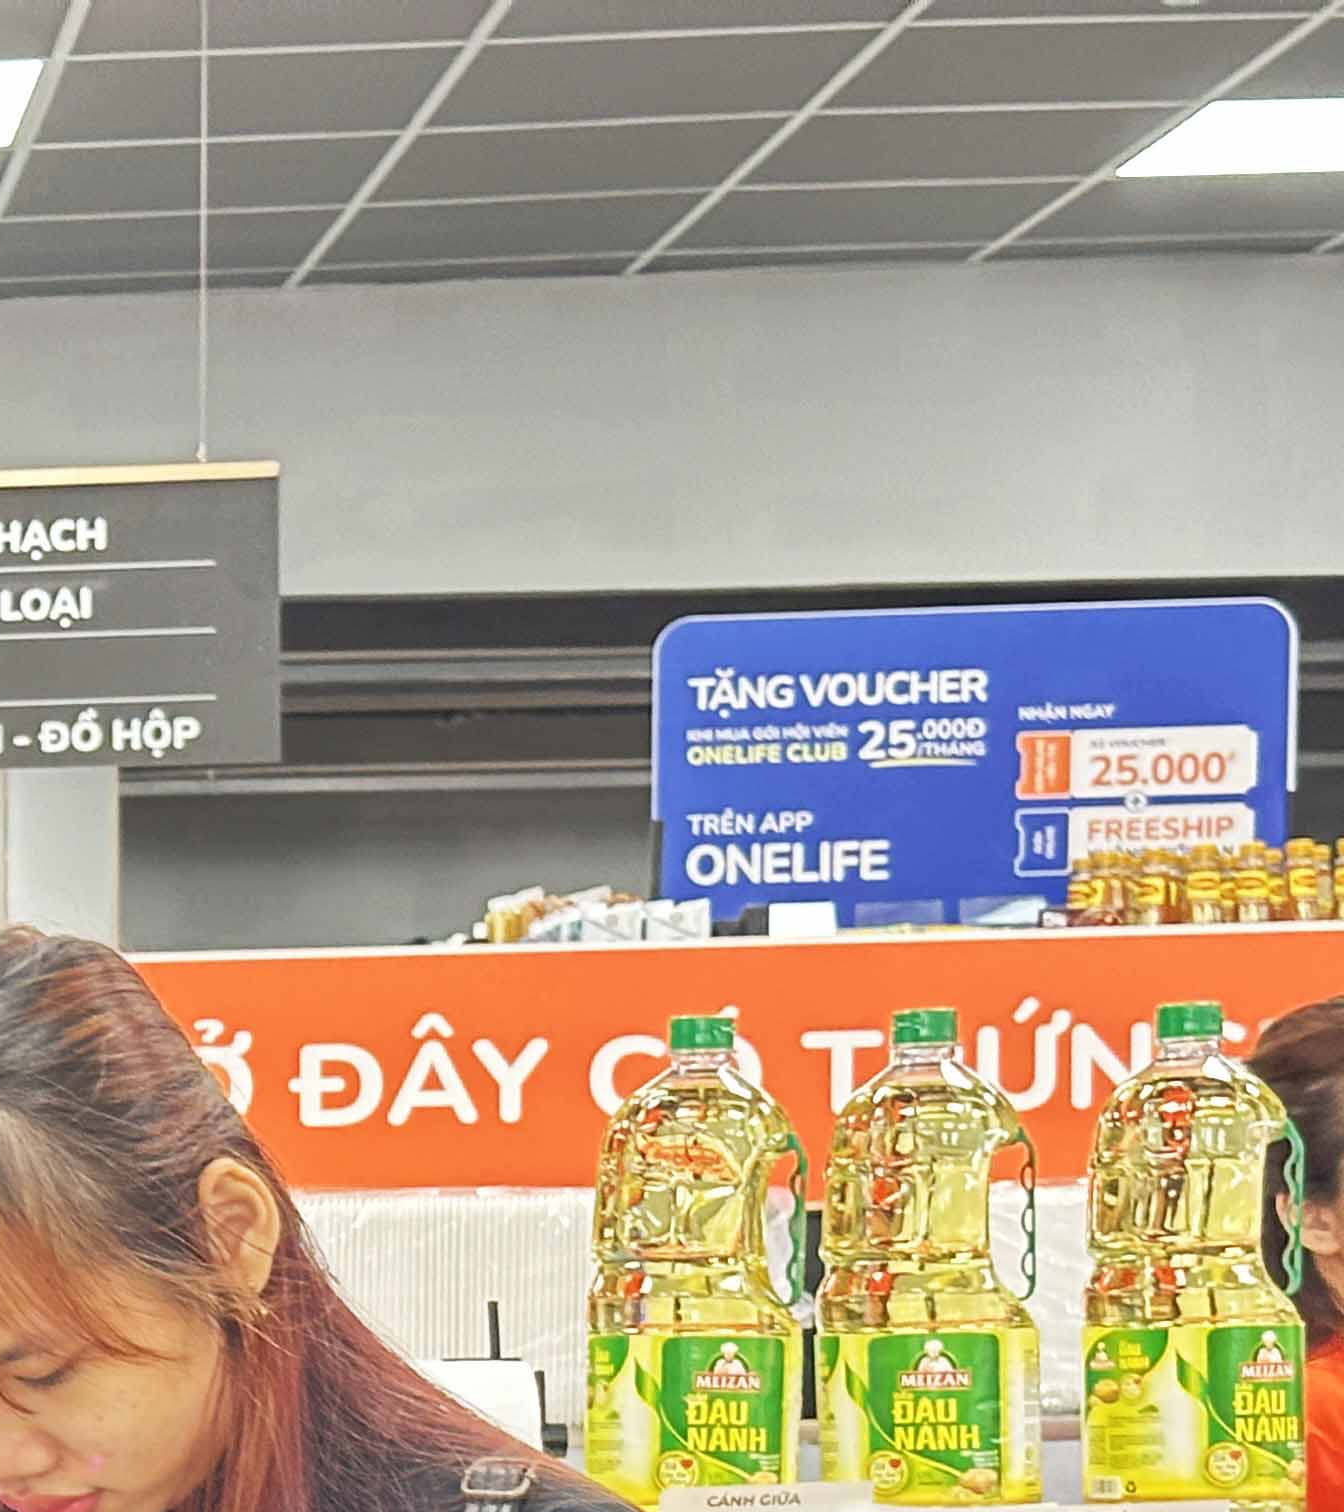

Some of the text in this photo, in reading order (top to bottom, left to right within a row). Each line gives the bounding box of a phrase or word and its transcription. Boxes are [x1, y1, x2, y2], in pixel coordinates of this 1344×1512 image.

[0, 586, 93, 629] LOẠI
[687, 667, 989, 719] TẶNG VOUCHER
[1070, 703, 1116, 720] NGAY
[38, 709, 102, 754] ĐỒ
[113, 708, 201, 759] HỘP
[687, 742, 848, 766] ONELIFE CLUB
[686, 807, 813, 836] TRÊN APP
[1088, 815, 1235, 842] FREESHIP
[686, 840, 891, 886] ONELIFE
[288, 1012, 549, 1127] ĐÂY
[695, 1374, 761, 1390] MEIZAN
[900, 1373, 969, 1388] MEIZAN
[1240, 1364, 1295, 1379] MEIZAN
[707, 1491, 801, 1508] CÁNH GIỮA
